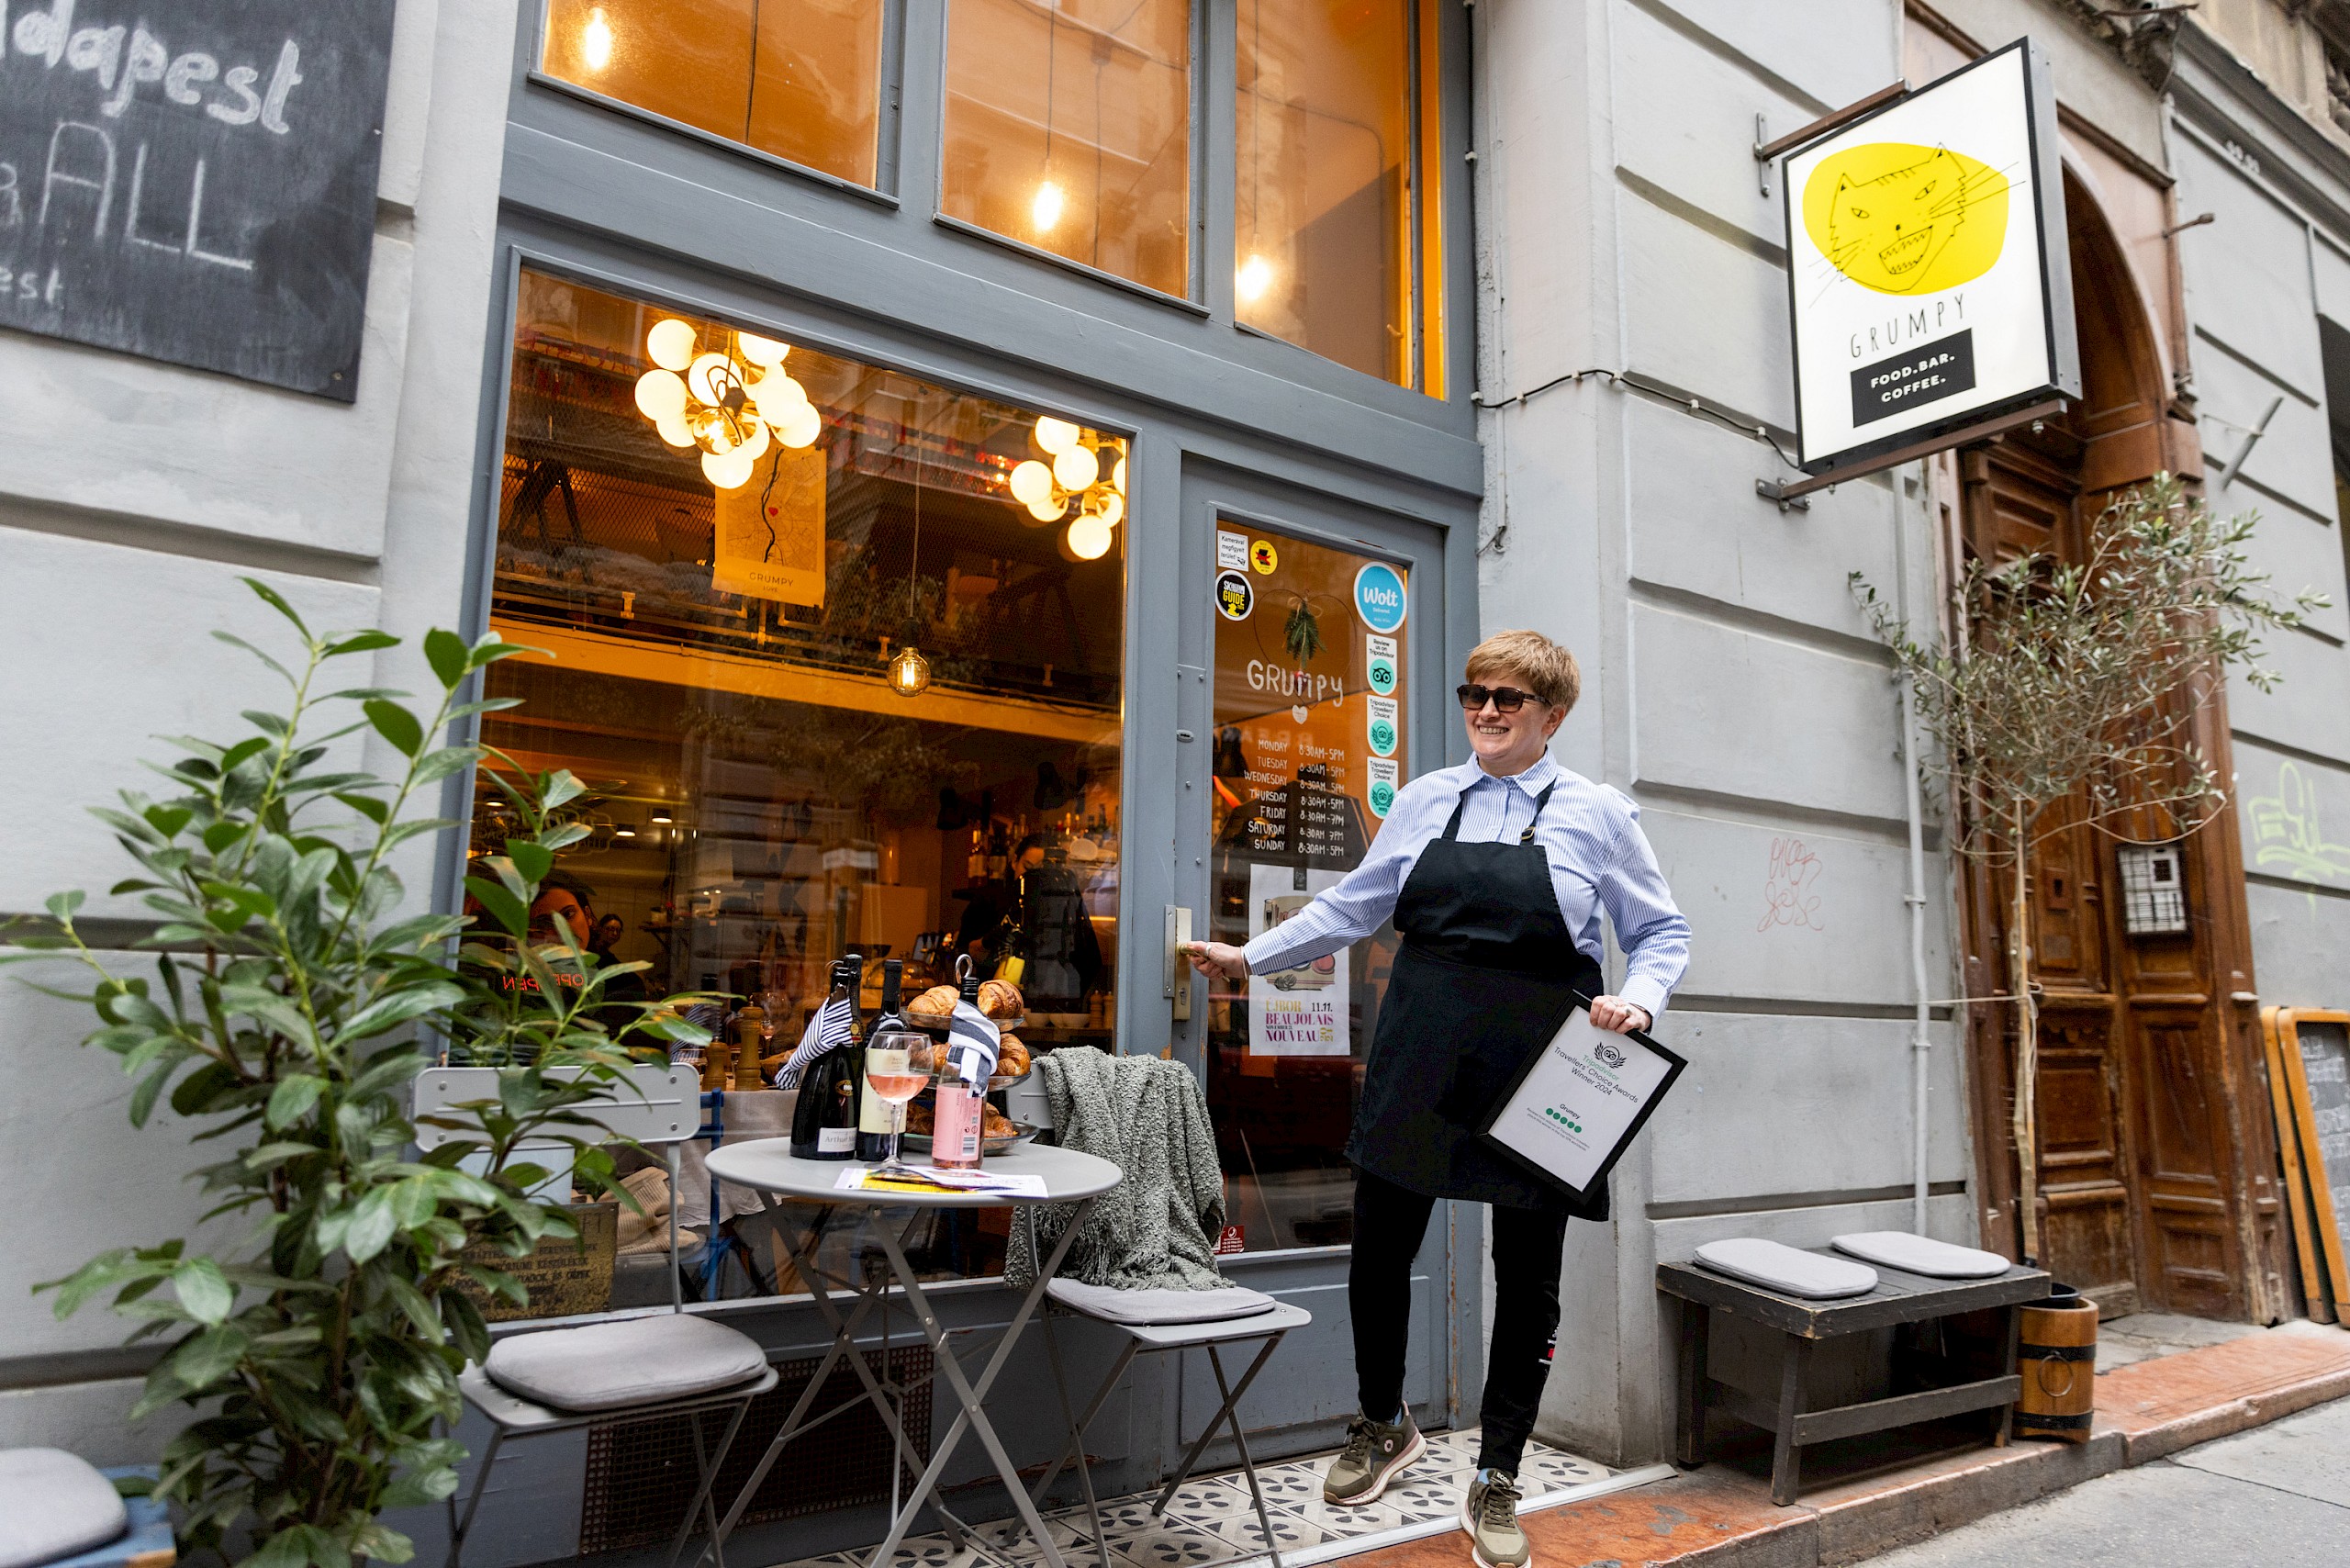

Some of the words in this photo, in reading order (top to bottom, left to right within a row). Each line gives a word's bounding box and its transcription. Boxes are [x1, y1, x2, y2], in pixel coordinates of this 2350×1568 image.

[0, 0, 303, 134] dapest
[1851, 293, 1967, 359] GRUMPY
[1881, 375, 1946, 402] COFFEE.
[750, 572, 793, 587] GRUMPY
[1223, 589, 1245, 606] GUIDE
[1364, 587, 1398, 607] Wolt
[1369, 649, 1394, 658] Tripadvisor
[1370, 699, 1395, 708] Tripadvisor
[1258, 739, 1288, 753] MONDAY
[1257, 756, 1287, 770] TUESDAY
[1370, 761, 1395, 769] Tripadvisor
[1244, 770, 1287, 786] WEDNESDAY
[1249, 789, 1287, 803] THURSDAY
[1260, 805, 1286, 819] FRIDAY
[1248, 821, 1286, 835] SATURDAY
[1254, 839, 1285, 851] SUNDAY
[1266, 1013, 1333, 1025] BEAUJOLAIS
[1266, 1030, 1320, 1042] NOUVEAU
[1583, 1055, 1619, 1081] Tripadvisor
[1572, 1067, 1595, 1085] Winner
[1595, 1081, 1613, 1095] 2024
[1588, 1068, 1613, 1087] Choice
[1613, 1084, 1639, 1103] Awards
[1560, 1103, 1581, 1119] Grumpy
